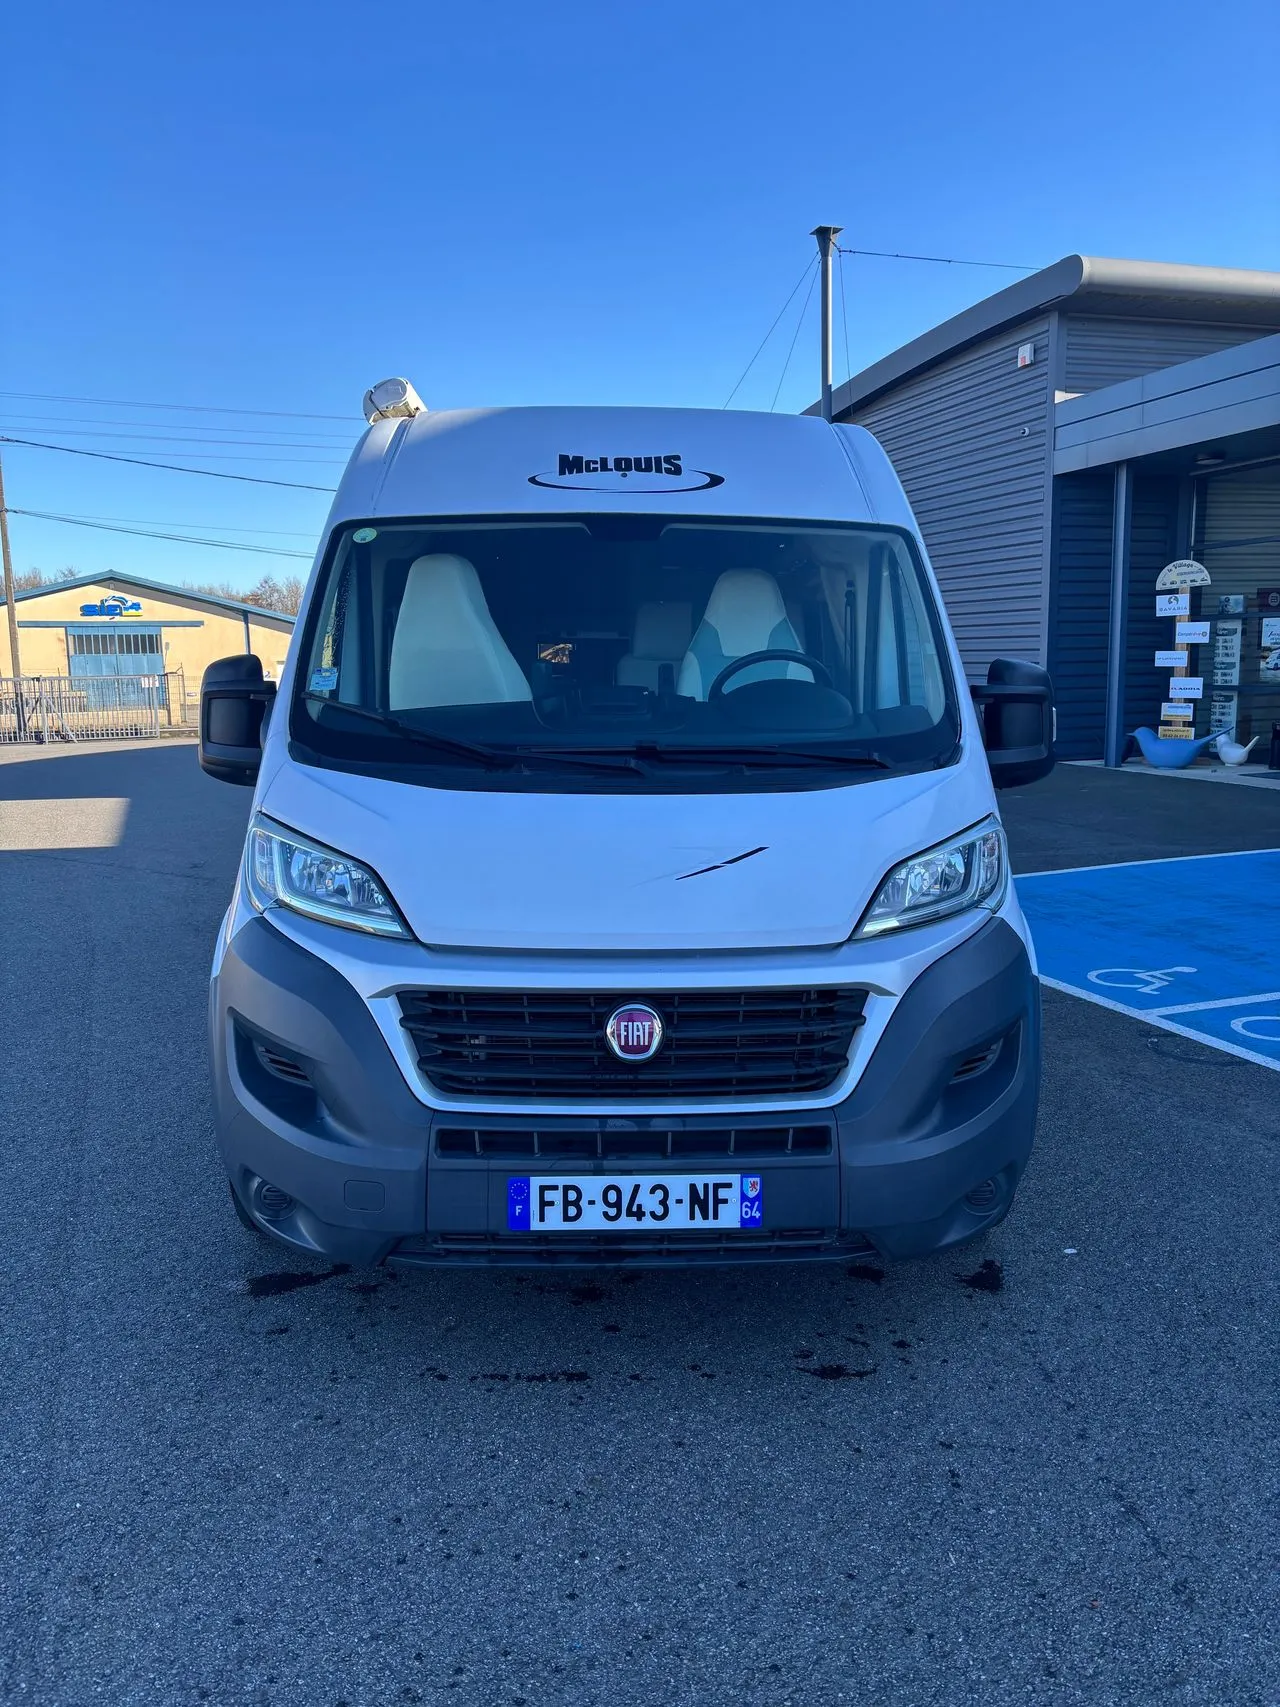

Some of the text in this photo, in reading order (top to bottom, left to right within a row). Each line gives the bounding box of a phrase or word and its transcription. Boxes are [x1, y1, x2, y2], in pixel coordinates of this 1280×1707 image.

[620, 1021, 651, 1046] FIAT
[515, 1206, 523, 1216] F
[538, 1182, 733, 1223] FB-943-NF
[741, 1201, 761, 1219] 64
